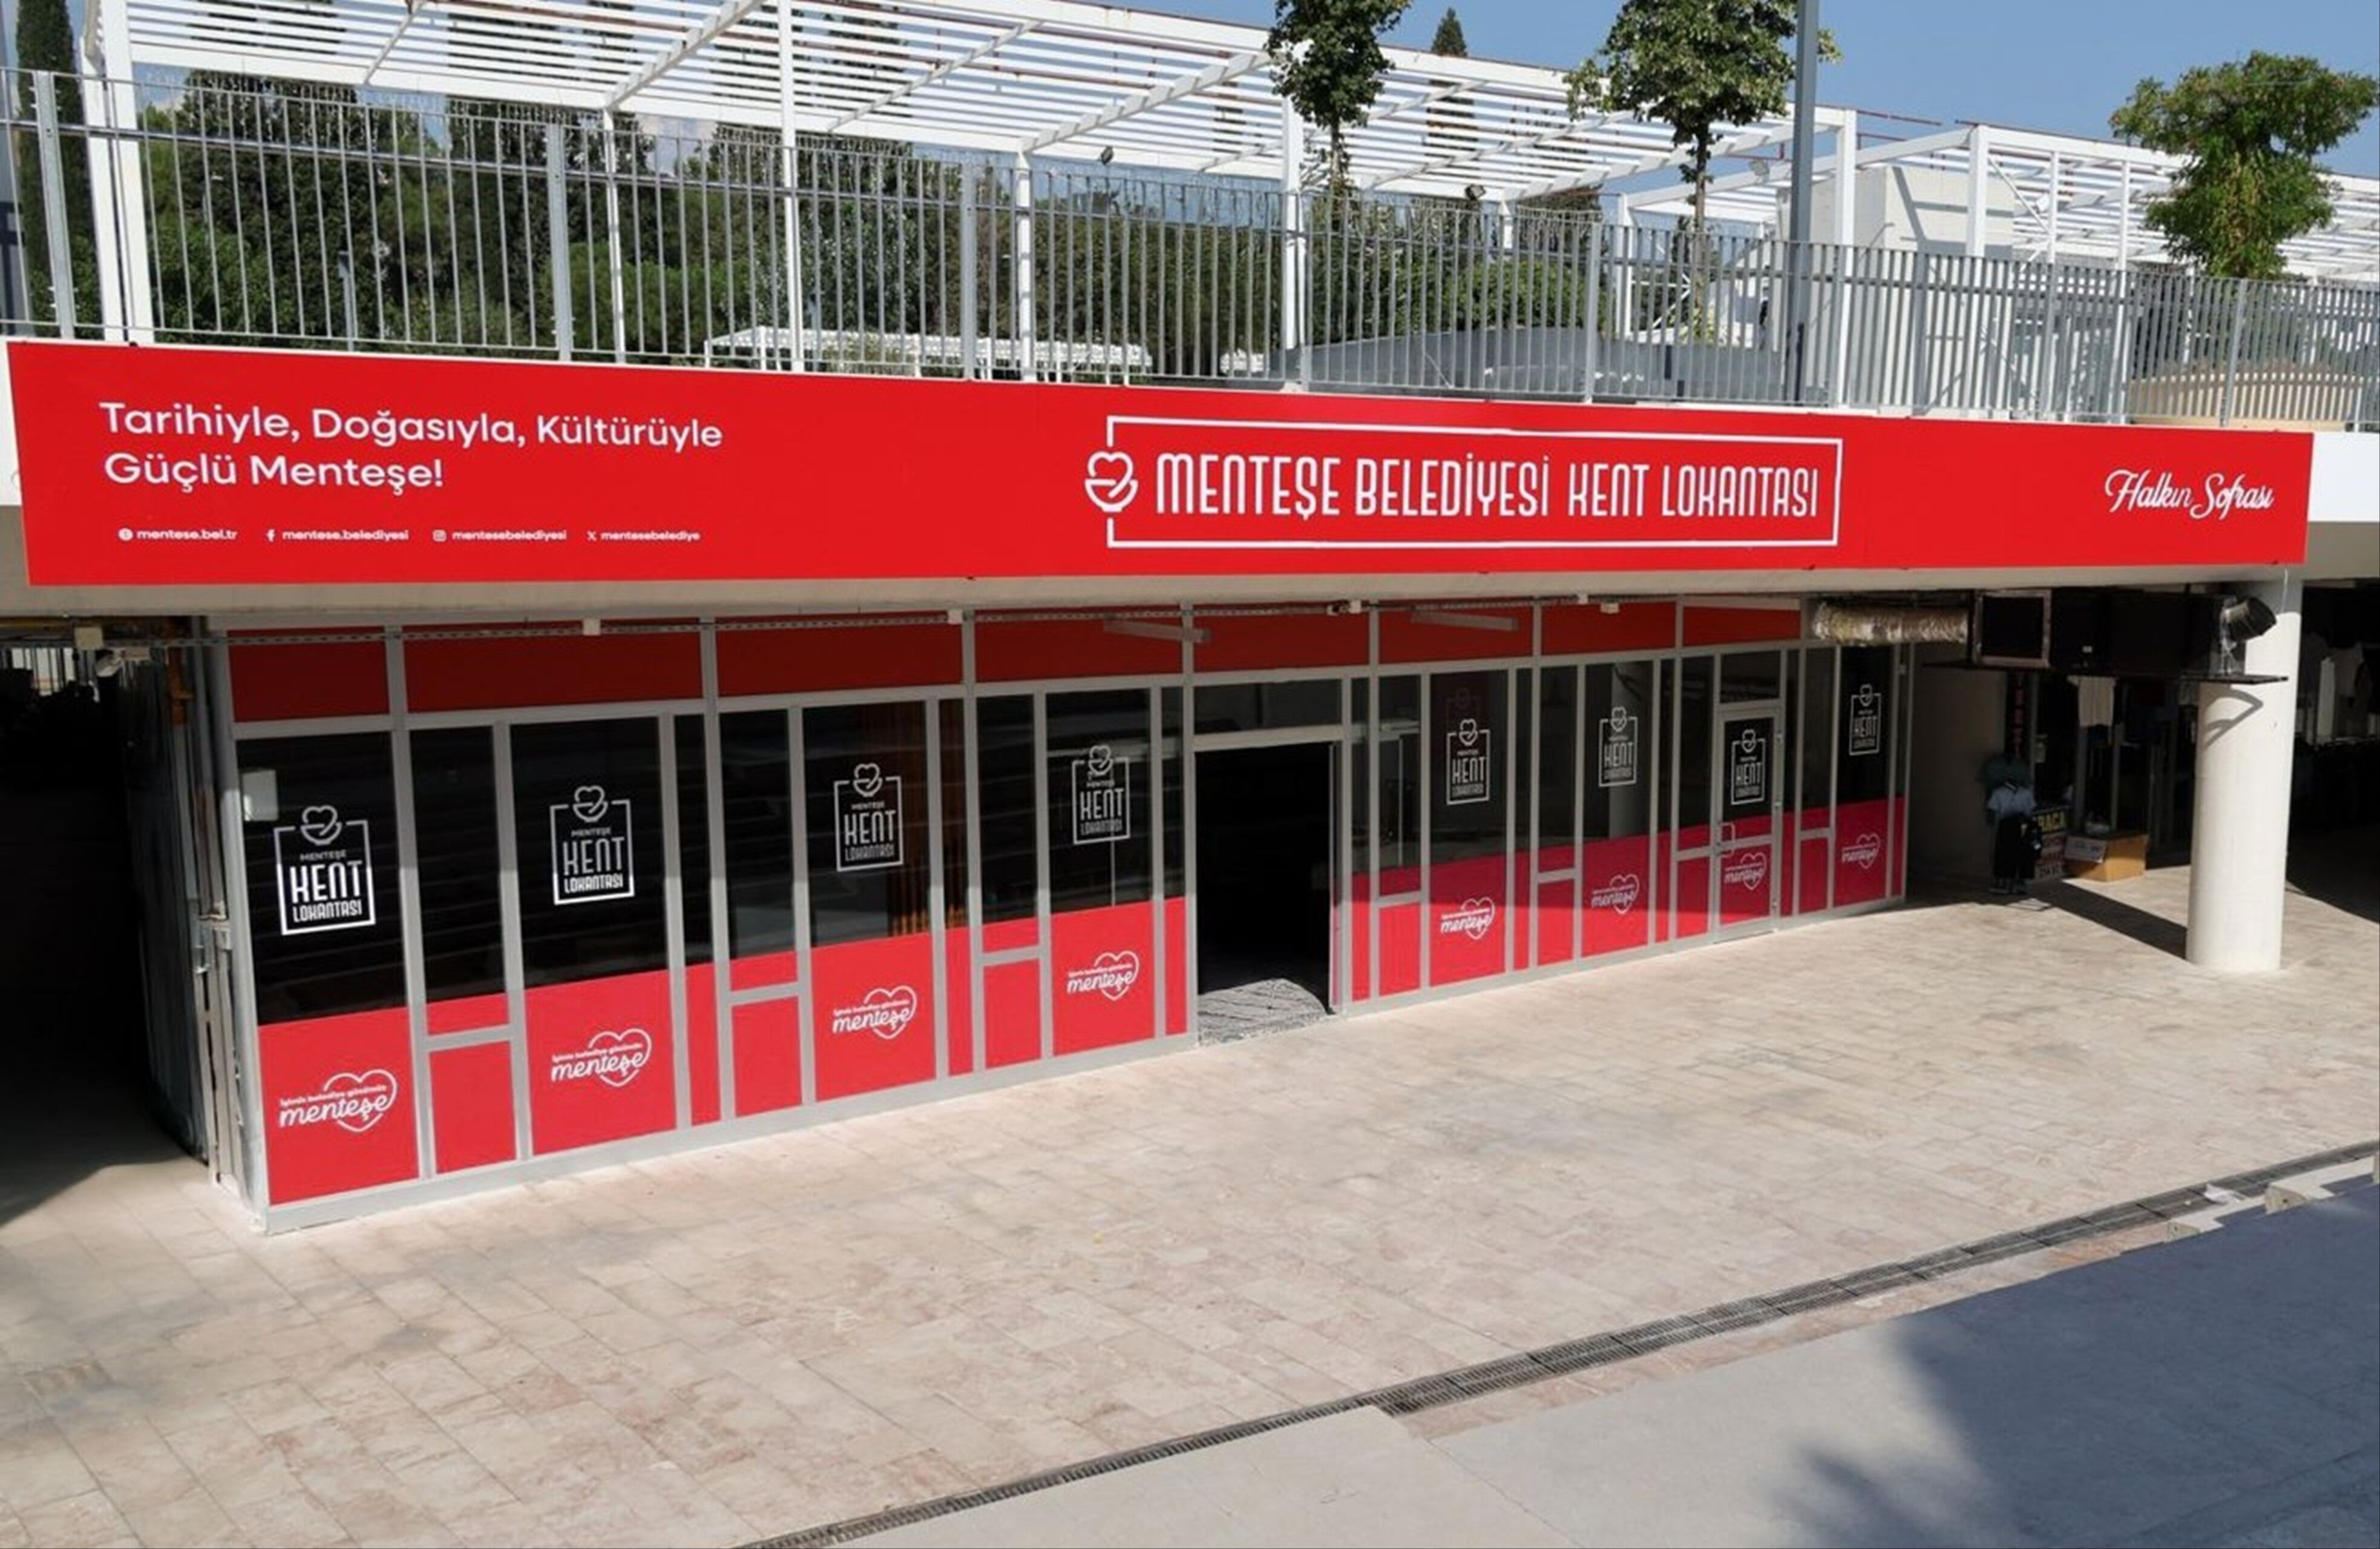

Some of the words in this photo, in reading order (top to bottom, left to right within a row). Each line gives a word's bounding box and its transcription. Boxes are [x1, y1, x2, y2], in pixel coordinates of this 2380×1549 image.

[99, 402, 300, 443] Tarihiyle,
[313, 409, 525, 449] Doğasıyla,
[537, 415, 723, 453] Kültürüyle
[105, 453, 237, 493] Güçlü
[249, 455, 443, 496] Menteşe!
[1156, 452, 1340, 520] MENTEŞE
[1355, 453, 1550, 516] BELEDİYESİ
[1568, 462, 1650, 517] KENT
[1661, 464, 1818, 518] LOKANTASI
[2105, 469, 2193, 513] Halkın
[2189, 472, 2275, 521] Sofrası
[137, 528, 238, 541] mentese.bel.tr
[283, 529, 410, 542] mentese.belediyesi
[452, 529, 567, 542] mentesebelediyesi
[600, 530, 700, 542] mentesebelediye
[1080, 788, 1124, 820] KENT
[844, 810, 896, 845] KENT
[562, 837, 625, 876] KENT
[289, 860, 362, 904] KENT
[563, 873, 623, 893] LOKANTASI
[292, 899, 362, 922] LOKANTASI
[832, 1007, 910, 1034] menteşe
[551, 1051, 643, 1082] menteşe
[279, 1094, 388, 1128] menteşe
